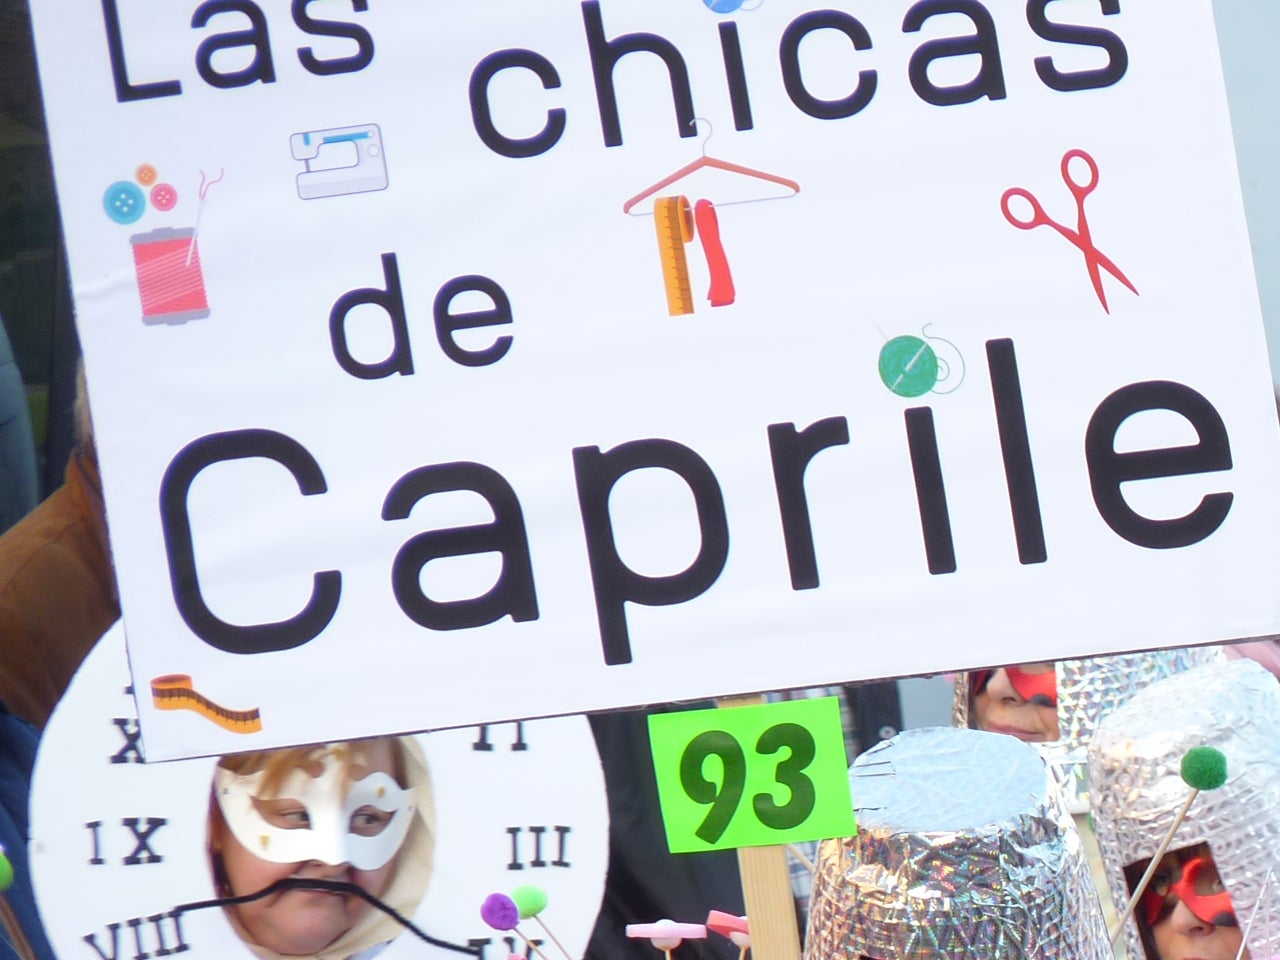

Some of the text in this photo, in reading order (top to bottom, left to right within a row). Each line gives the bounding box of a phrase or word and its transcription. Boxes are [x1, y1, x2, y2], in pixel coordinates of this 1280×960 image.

[102, 0, 1128, 158] Las chicas
[330, 253, 512, 379] de
[160, 338, 1234, 665] Caprile
[111, 719, 145, 764] X
[680, 723, 816, 845] 93
[87, 818, 166, 865] IX
[508, 826, 570, 870] III
